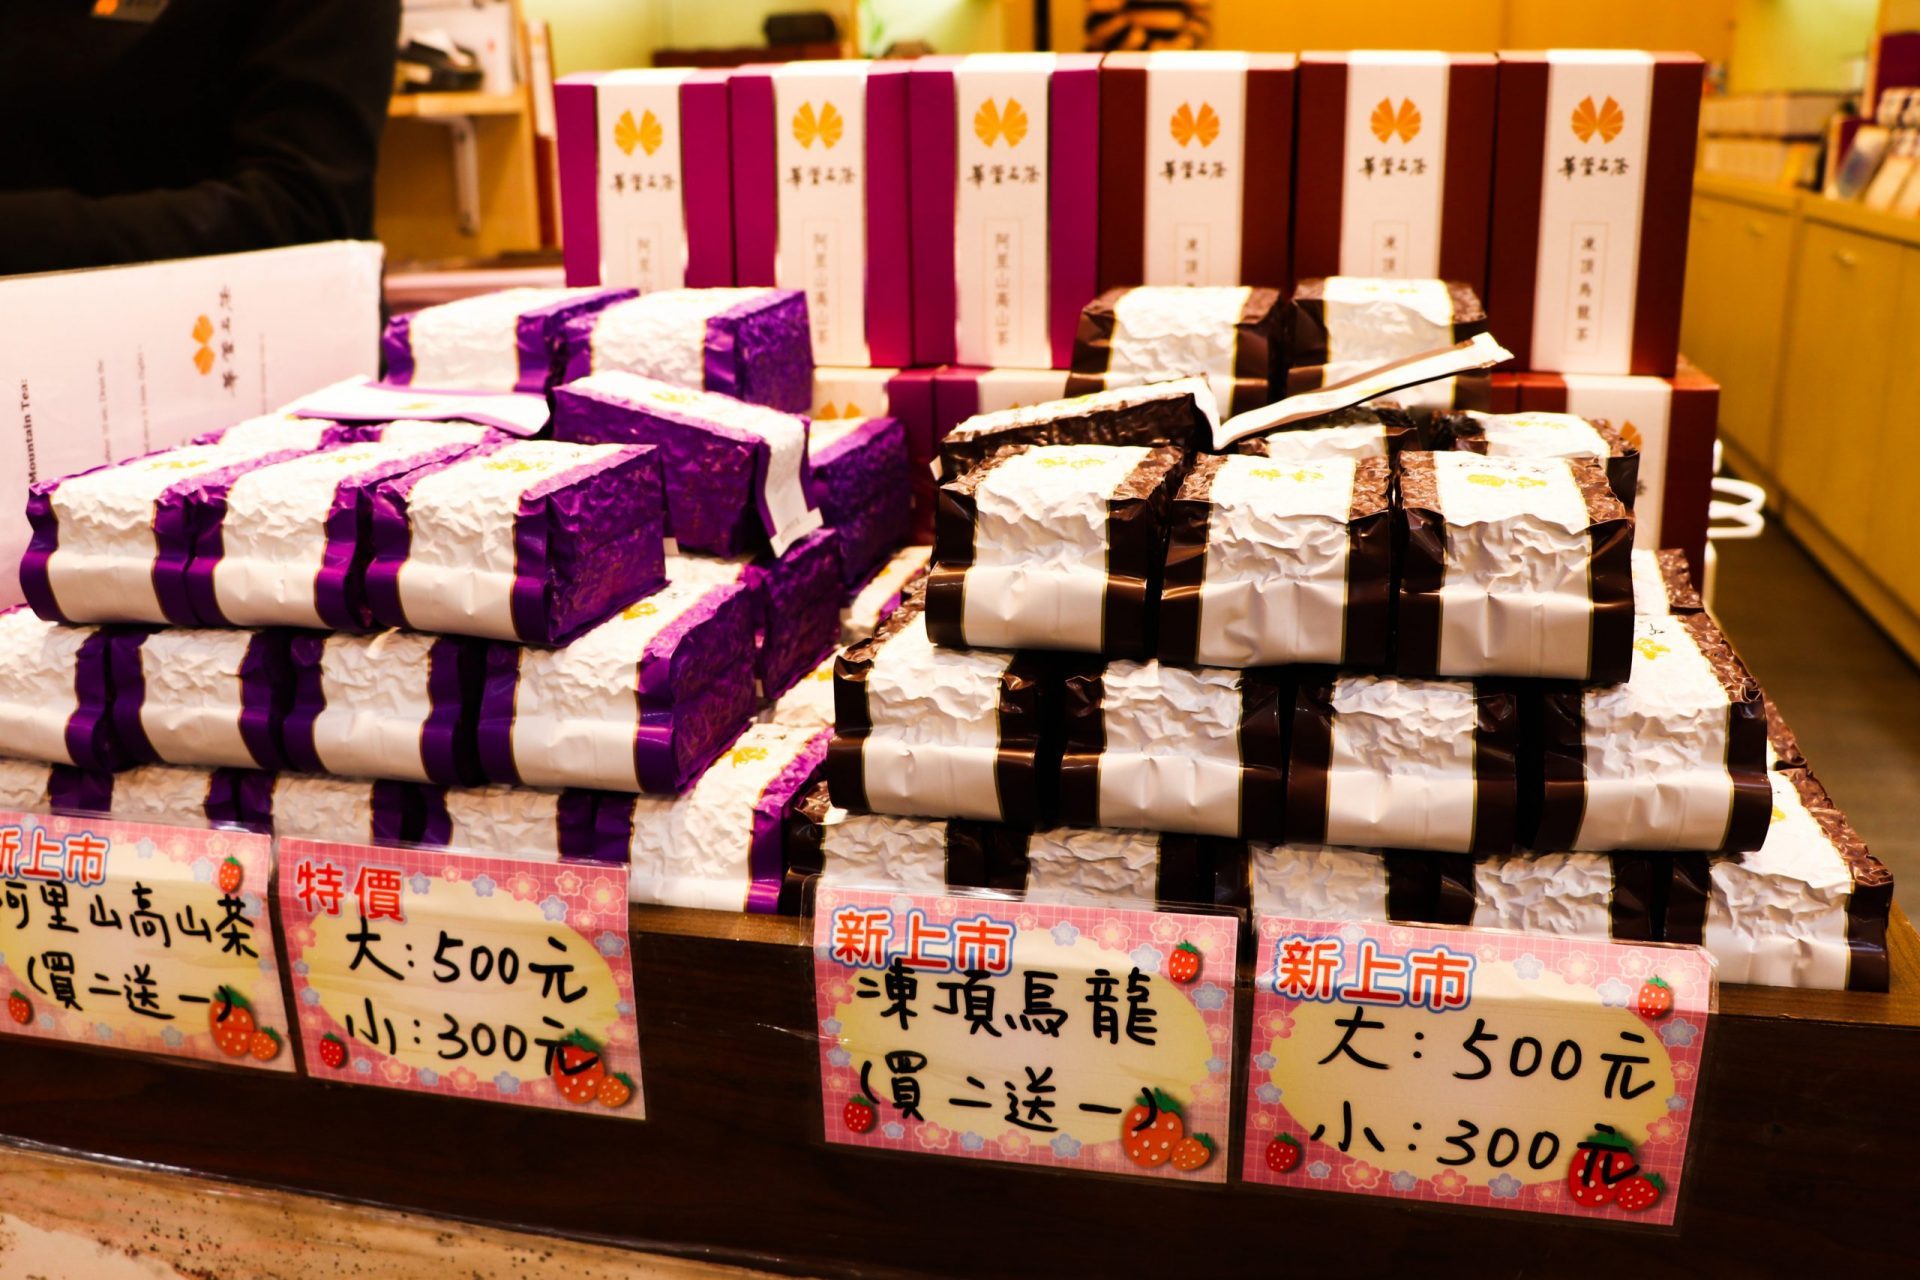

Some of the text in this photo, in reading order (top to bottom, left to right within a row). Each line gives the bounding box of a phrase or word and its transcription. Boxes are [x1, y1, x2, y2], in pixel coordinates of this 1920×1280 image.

[24, 413, 37, 483] Mountain
[296, 860, 405, 922] 特價
[832, 907, 1015, 974] 新上市
[1274, 937, 1474, 1011] 新上市
